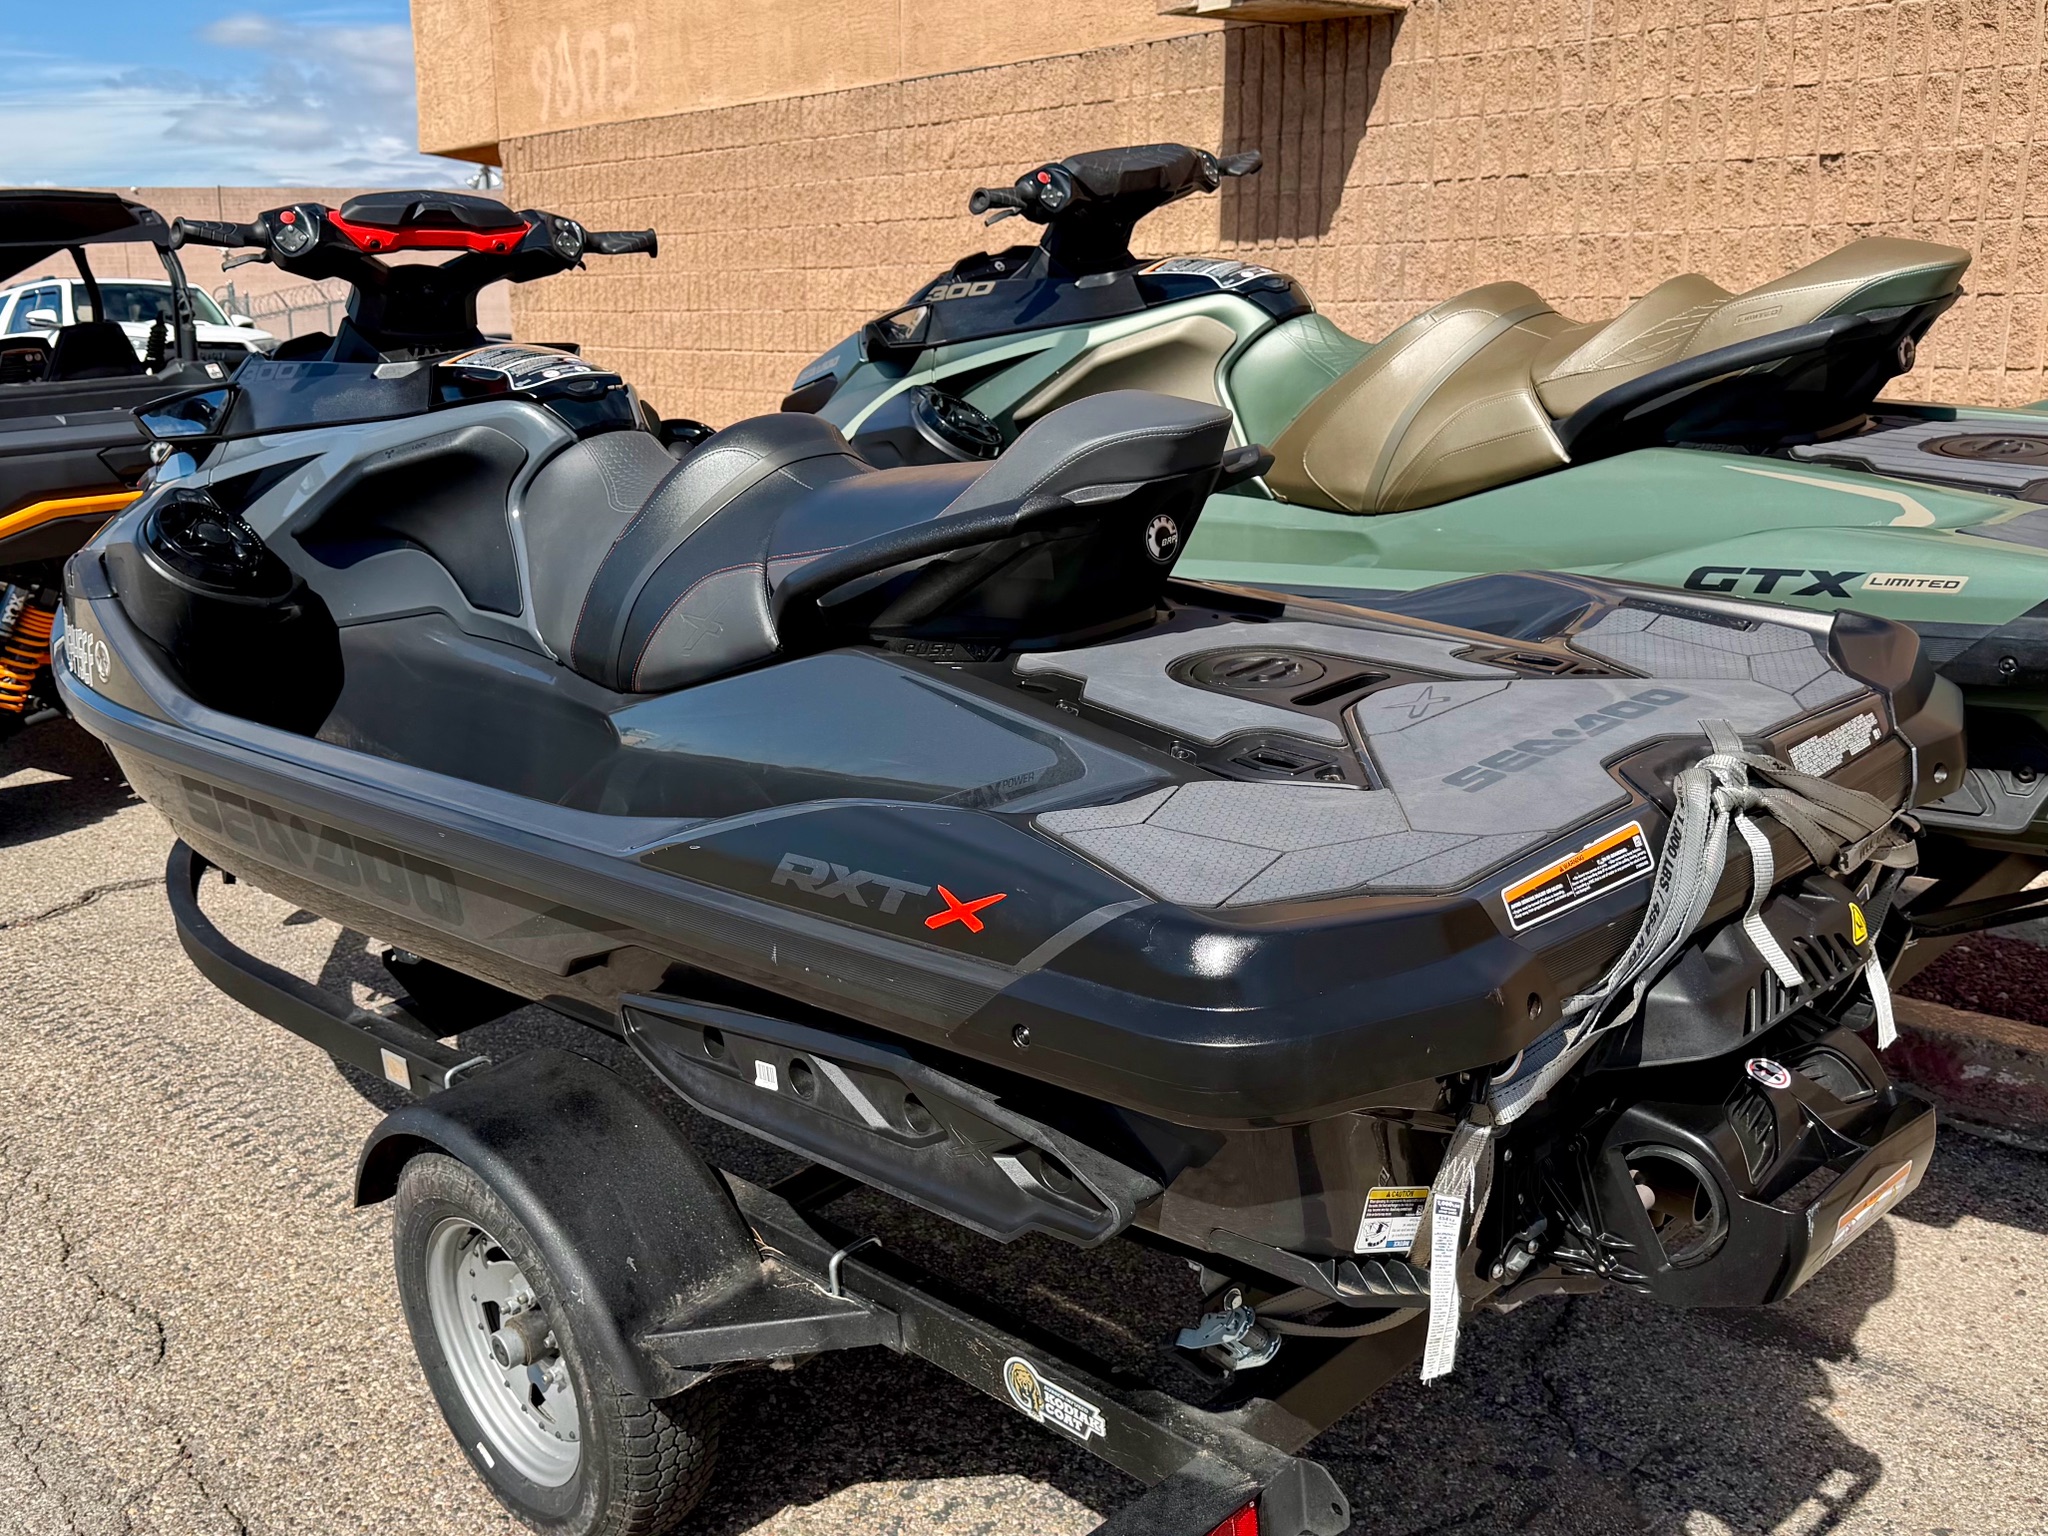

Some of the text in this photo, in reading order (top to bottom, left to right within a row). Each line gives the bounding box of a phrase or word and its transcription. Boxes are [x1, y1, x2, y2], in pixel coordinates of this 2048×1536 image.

[926, 281, 996, 301] 300
[1684, 566, 1961, 598] GTX LIMITED
[1, 593, 25, 625] FOX
[1002, 771, 1035, 788] POWER
[1659, 860, 1675, 893] LBS
[771, 852, 1008, 934] RXT X
[1391, 1190, 1415, 1198] CAUTION
[1044, 1390, 1103, 1432] KODIAK
[1045, 1402, 1083, 1431] COAT
